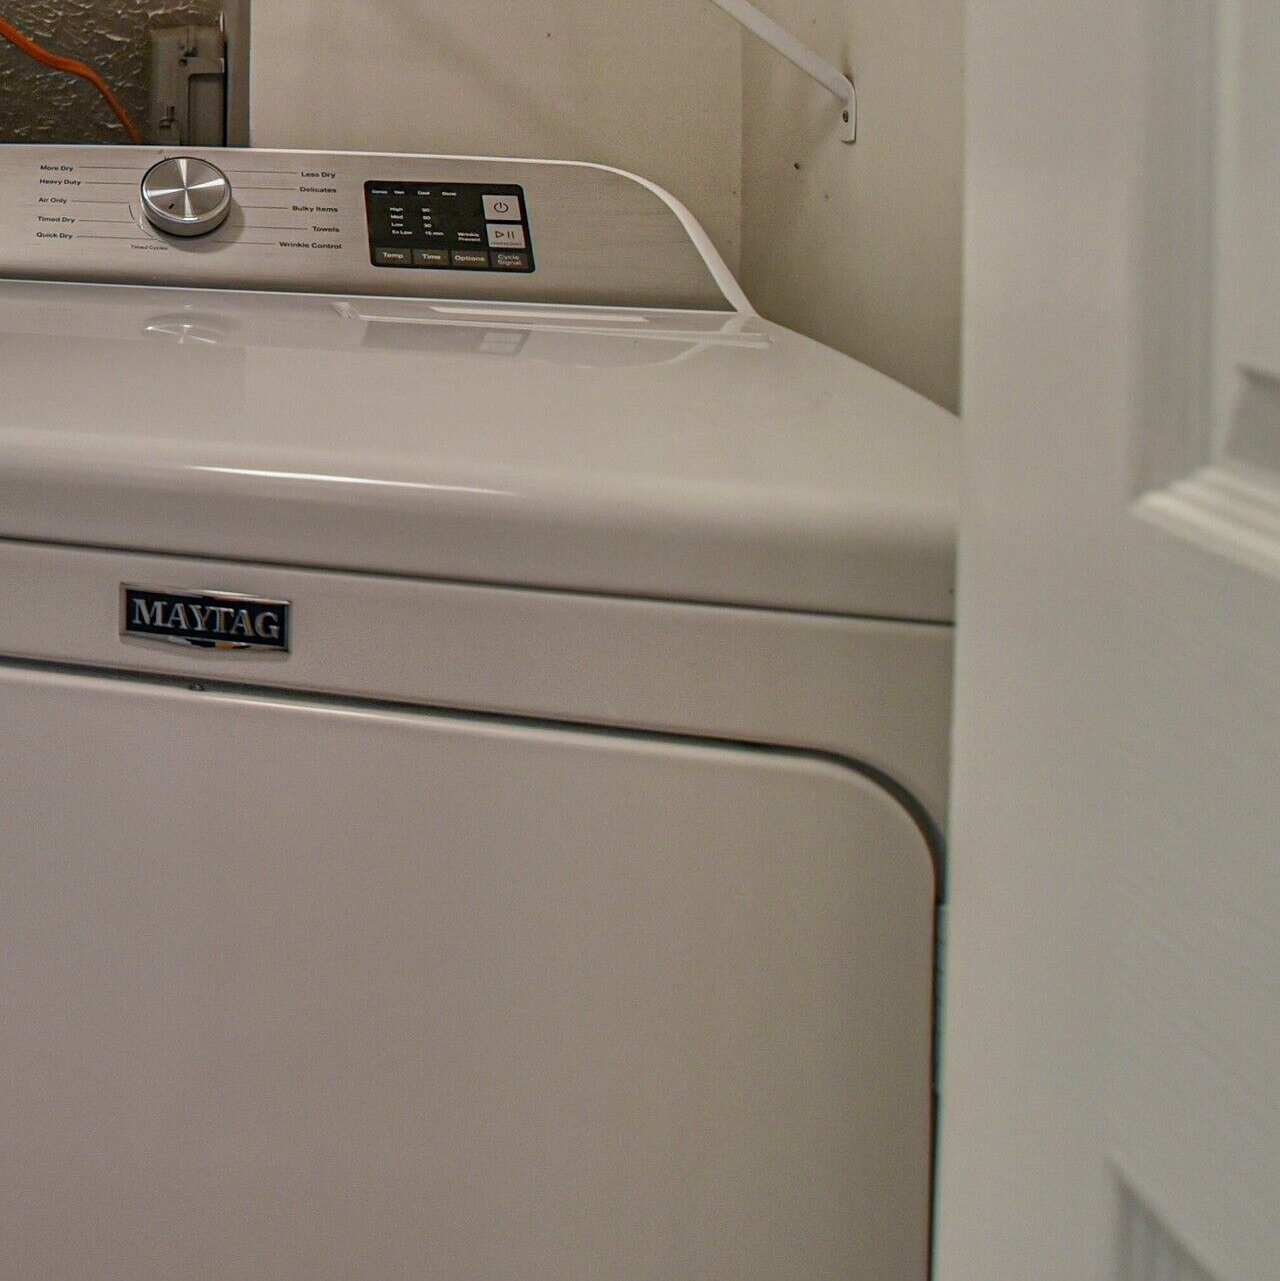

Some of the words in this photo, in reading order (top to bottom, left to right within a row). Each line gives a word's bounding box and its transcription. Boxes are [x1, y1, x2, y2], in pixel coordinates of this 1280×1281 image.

[300, 186, 337, 194] Delicates
[292, 205, 314, 213] Bulky
[312, 225, 340, 233] Towels
[279, 241, 310, 249] Wrinkle
[131, 598, 280, 640] MAYTAG
